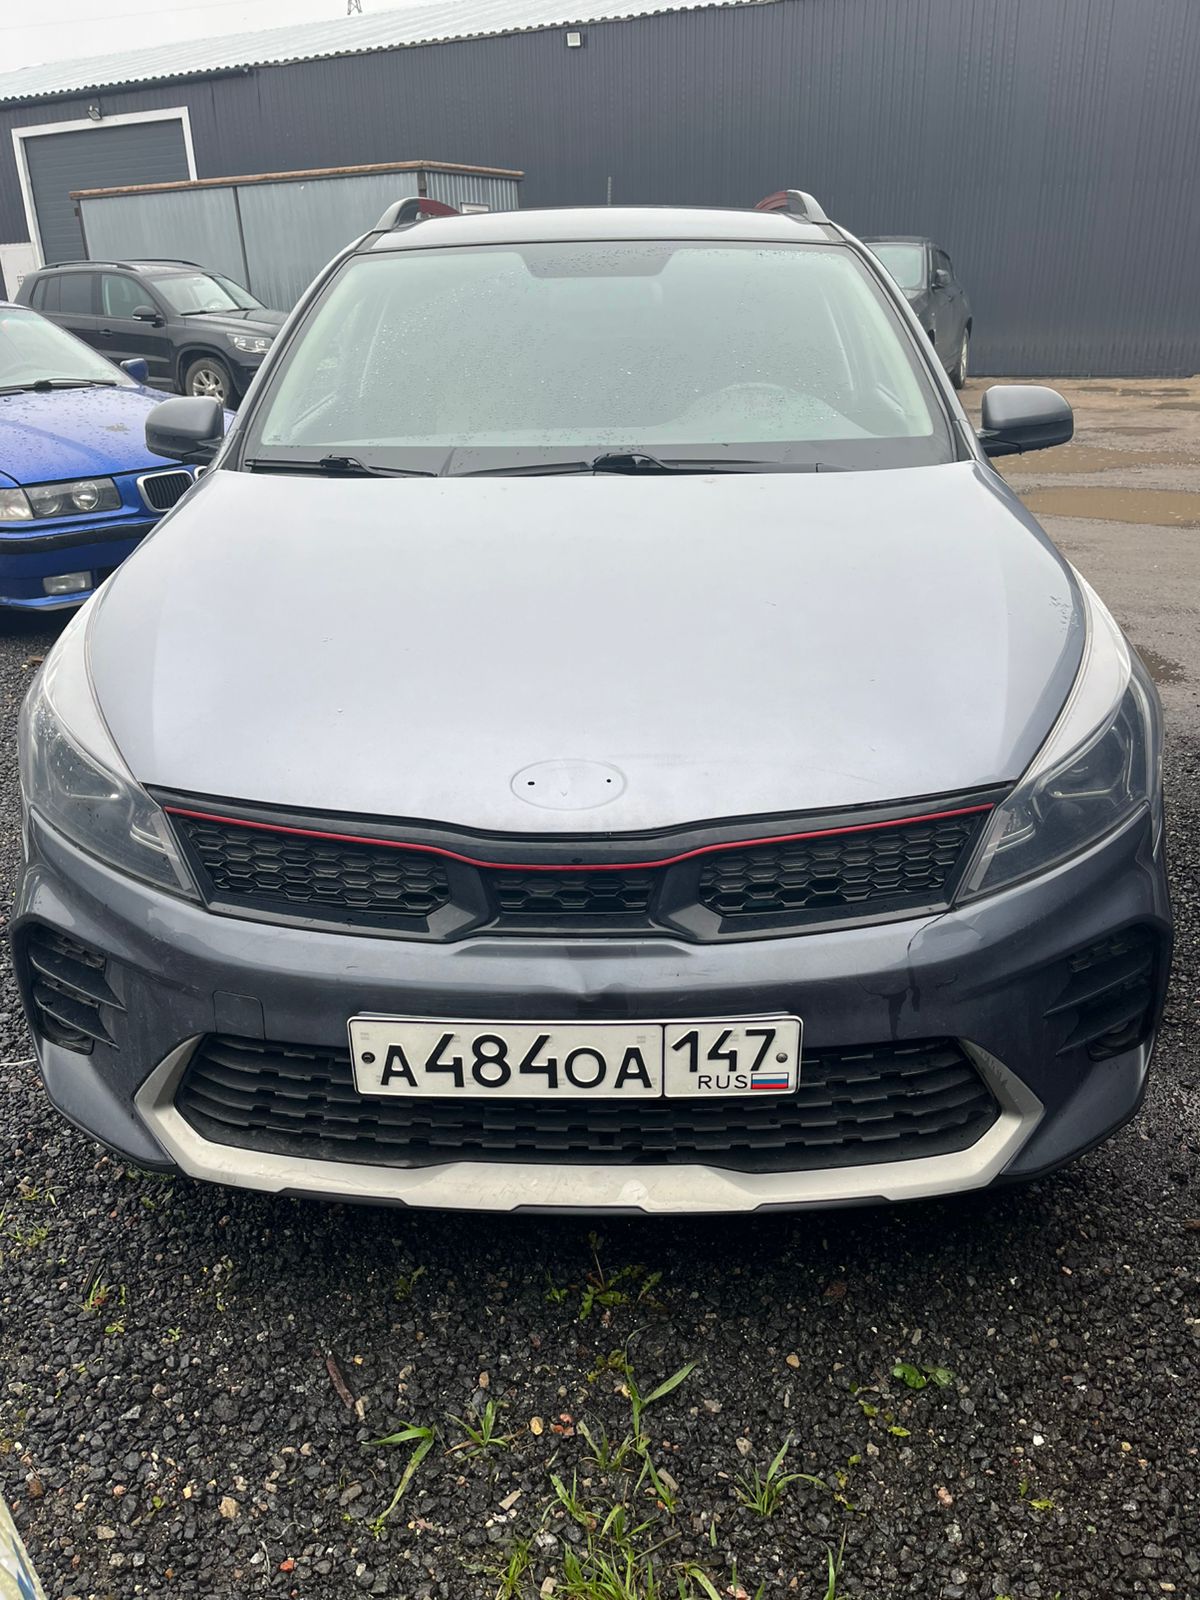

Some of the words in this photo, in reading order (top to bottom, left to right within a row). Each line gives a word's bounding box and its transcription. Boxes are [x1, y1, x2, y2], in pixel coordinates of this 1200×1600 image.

[380, 1033, 653, 1088] А484ОА
[671, 1028, 776, 1072] 147
[698, 1074, 748, 1089] RUS
